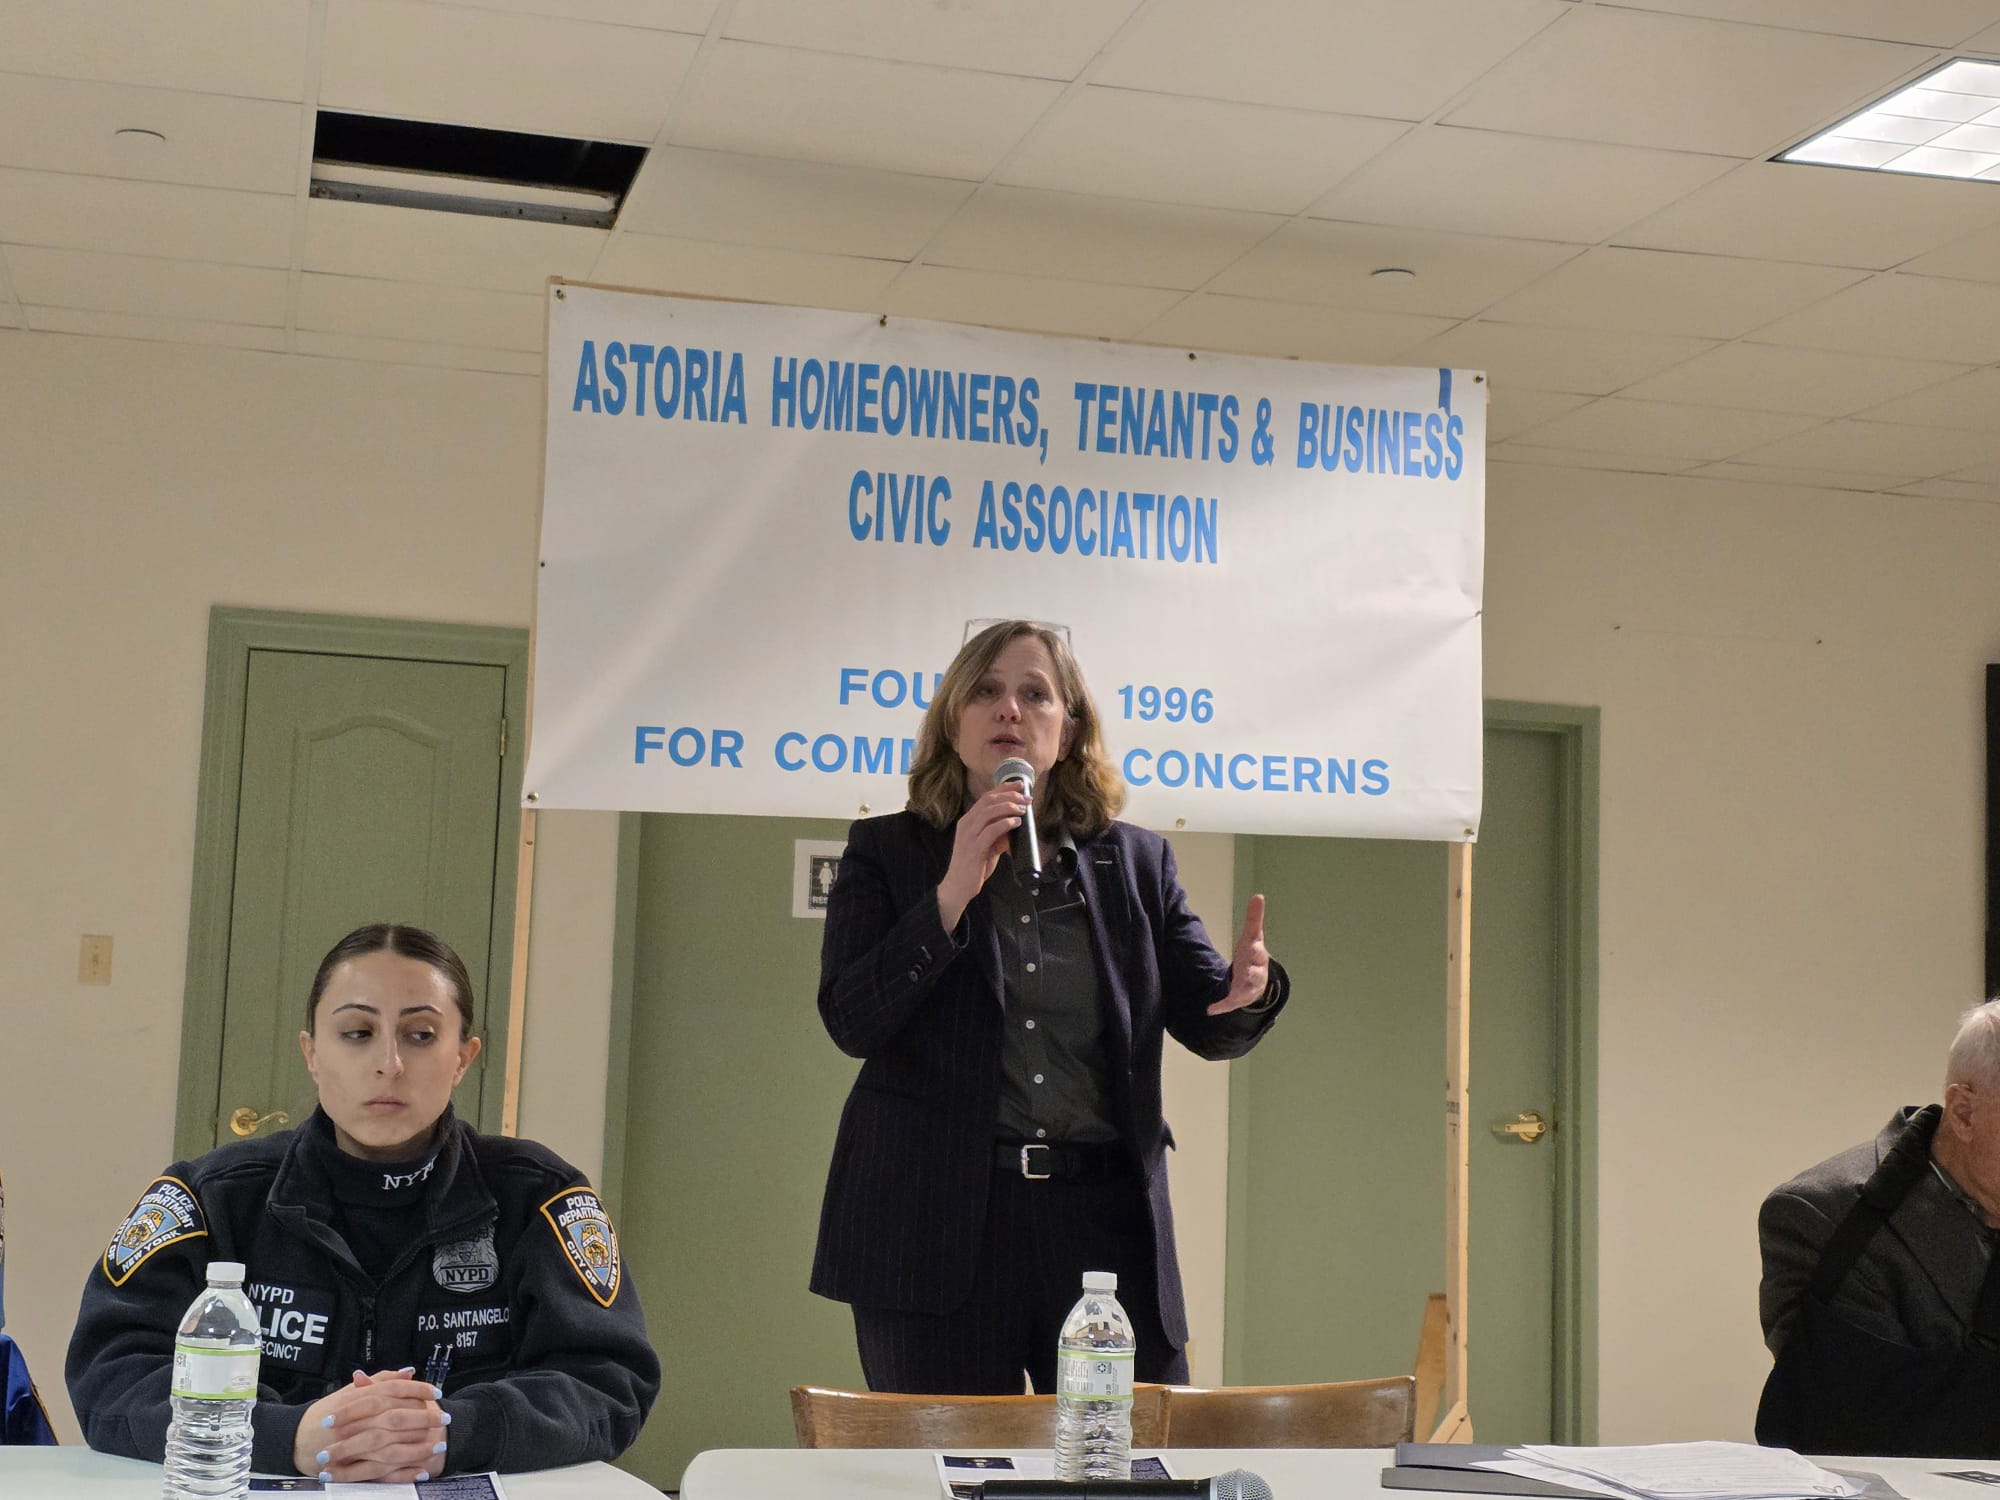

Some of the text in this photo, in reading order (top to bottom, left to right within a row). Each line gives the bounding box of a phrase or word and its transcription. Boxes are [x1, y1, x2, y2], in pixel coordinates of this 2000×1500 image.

[573, 340, 1464, 481] ASTORIA HOMEOWNERS, TENANTS & BUSINESS
[848, 470, 1217, 564] CIVIC ASSOCIATION
[839, 668, 1214, 724] FOU 1996
[634, 726, 1390, 796] FOR COM CONCERNS
[381, 1154, 439, 1190] NYP
[158, 1184, 195, 1212] POLICE
[566, 1195, 599, 1209] POLICE
[122, 1230, 182, 1272] NEW YORK
[566, 1240, 598, 1285] CITY OF
[445, 1268, 489, 1282] NYPD
[248, 1283, 295, 1305] NYPD
[256, 1306, 329, 1344] LICE
[418, 1307, 509, 1331] P.O. SANTANGELO
[260, 1340, 302, 1361] ECINCT
[456, 1331, 478, 1348] 8157
